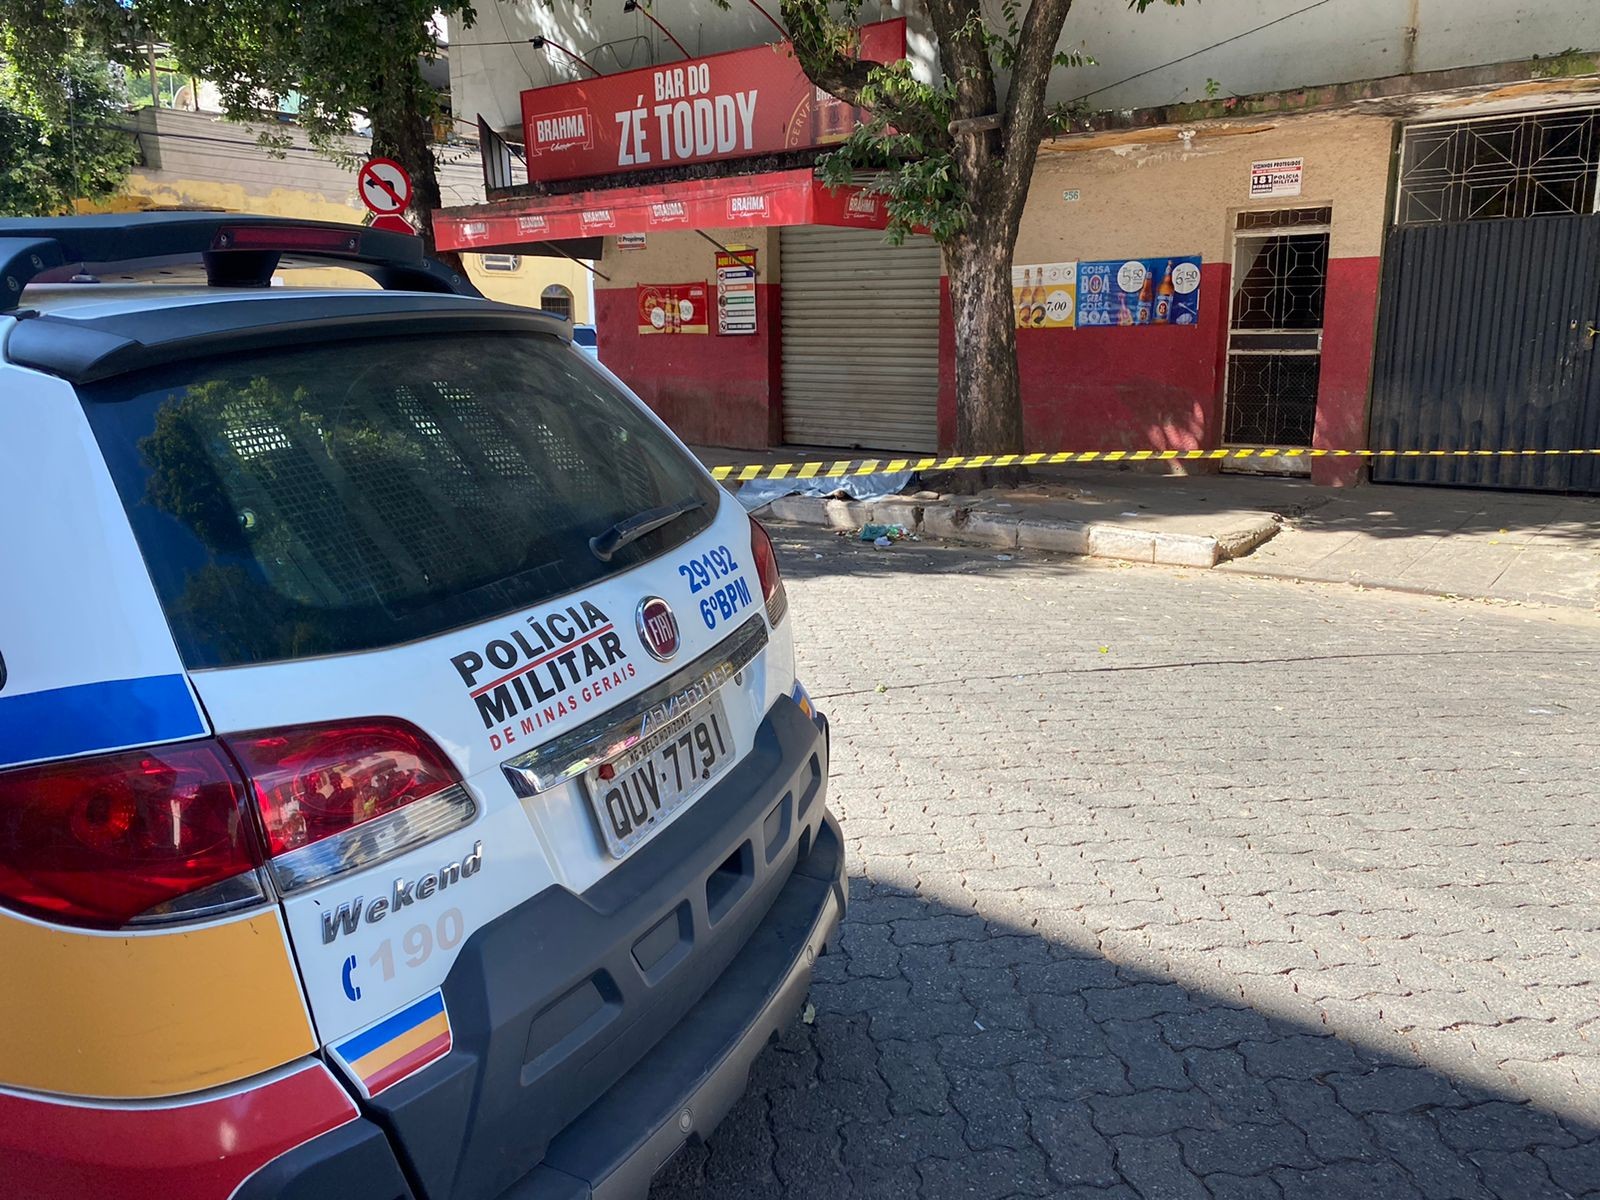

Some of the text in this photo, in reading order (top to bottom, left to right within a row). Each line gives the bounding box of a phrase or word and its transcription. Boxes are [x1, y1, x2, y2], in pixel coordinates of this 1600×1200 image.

[654, 63, 710, 101] BAR DO
[537, 114, 585, 142] BRAHMA
[615, 89, 758, 166] ZÉ TODDY
[1064, 190, 1079, 201] 256
[1253, 175, 1273, 184] 181
[652, 202, 685, 216] BRAHMA
[732, 195, 765, 211] BRAHMA
[1081, 265, 1111, 275] COISA
[1047, 301, 1067, 312] 7,00
[1079, 311, 1111, 324] BOA
[1080, 301, 1111, 311] COISA
[679, 545, 739, 594] 29192
[700, 576, 752, 630] 6ºBPM
[450, 600, 610, 688] POLÍCIA
[648, 612, 674, 648] FIAT
[473, 631, 627, 730] MILITAR
[489, 662, 637, 751] DE MINAS GERAIS
[369, 907, 465, 982] 190
